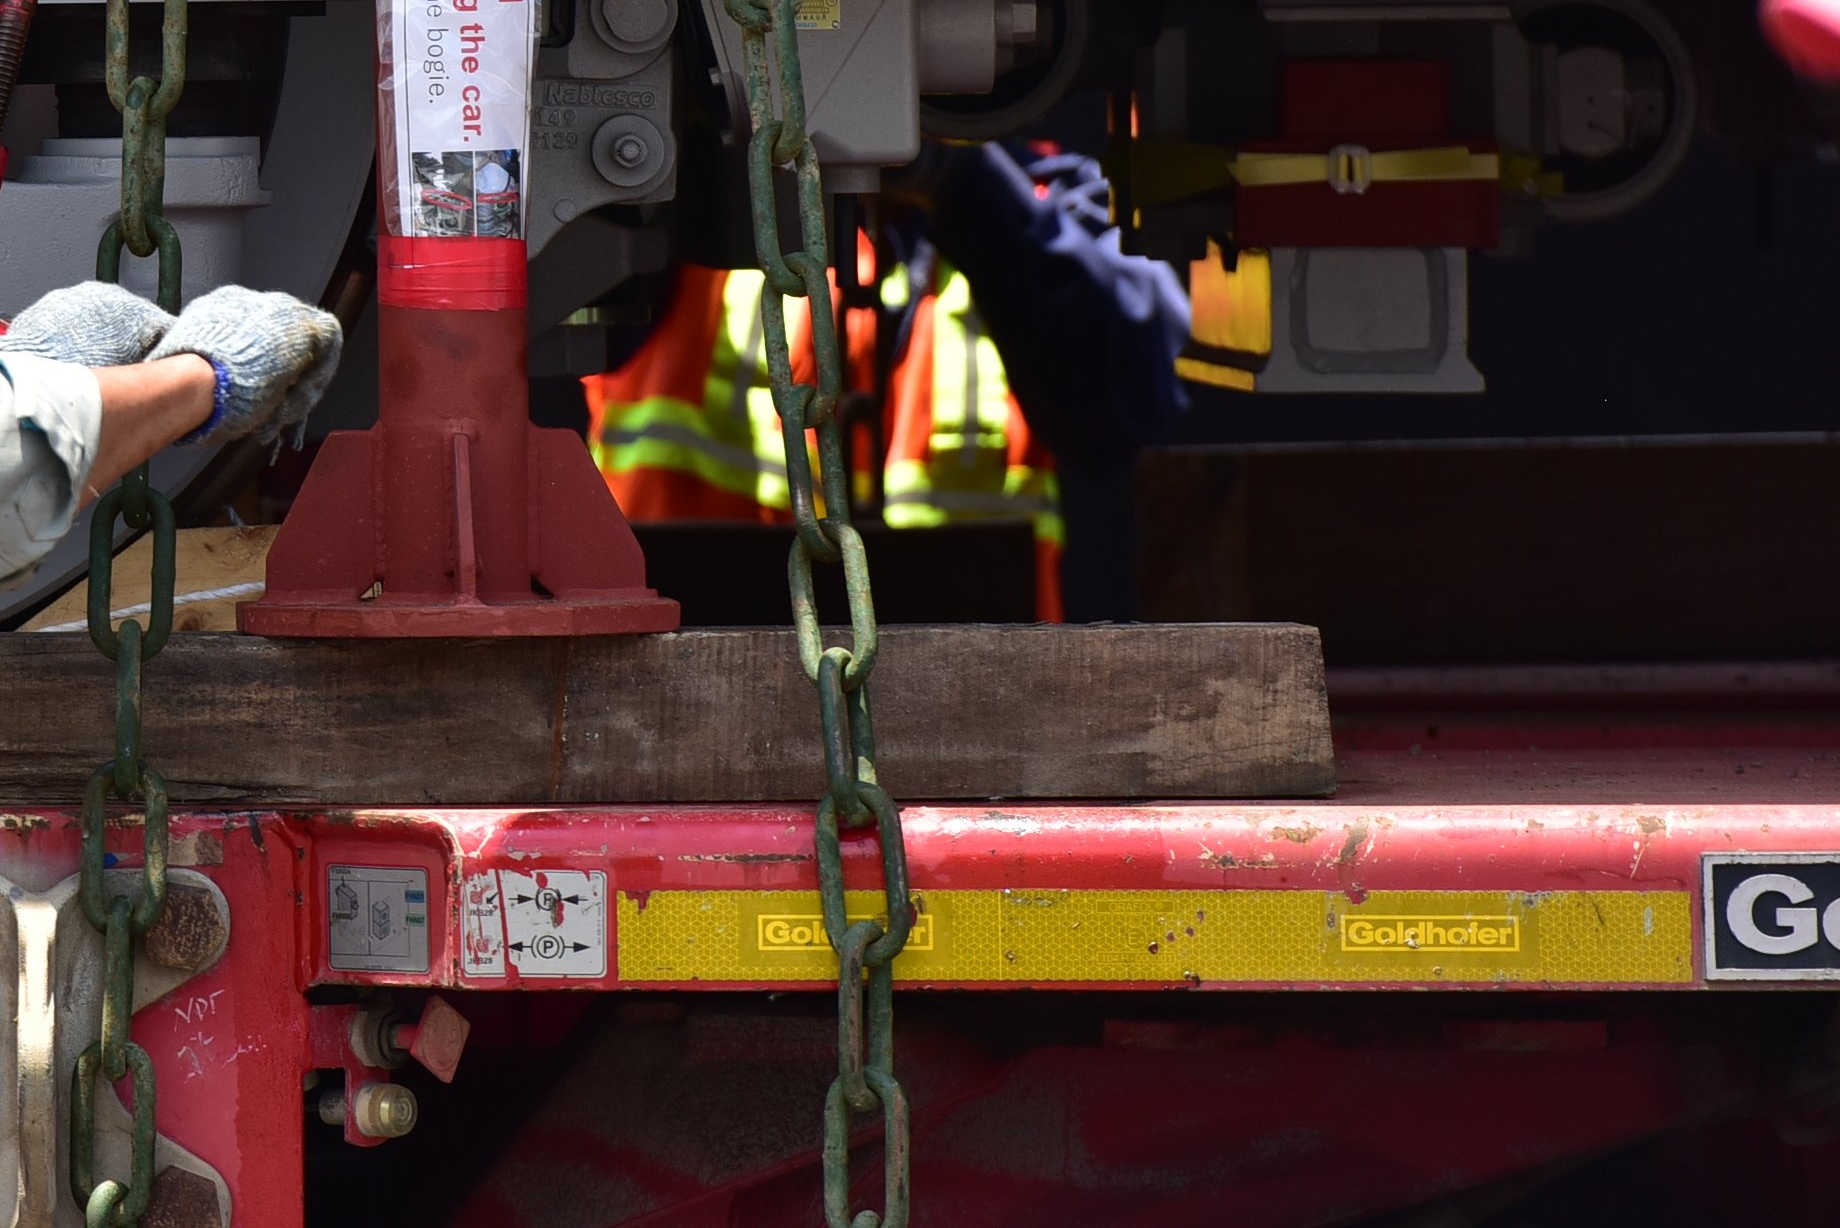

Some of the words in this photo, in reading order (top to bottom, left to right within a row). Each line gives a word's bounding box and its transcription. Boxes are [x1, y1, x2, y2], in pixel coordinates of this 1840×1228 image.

[423, 28, 450, 104] bogie.
[460, 23, 486, 74] the
[462, 85, 482, 142] car.
[1348, 921, 1512, 945] Goldhofer
[1726, 873, 1840, 955] G
[543, 940, 554, 954] P
